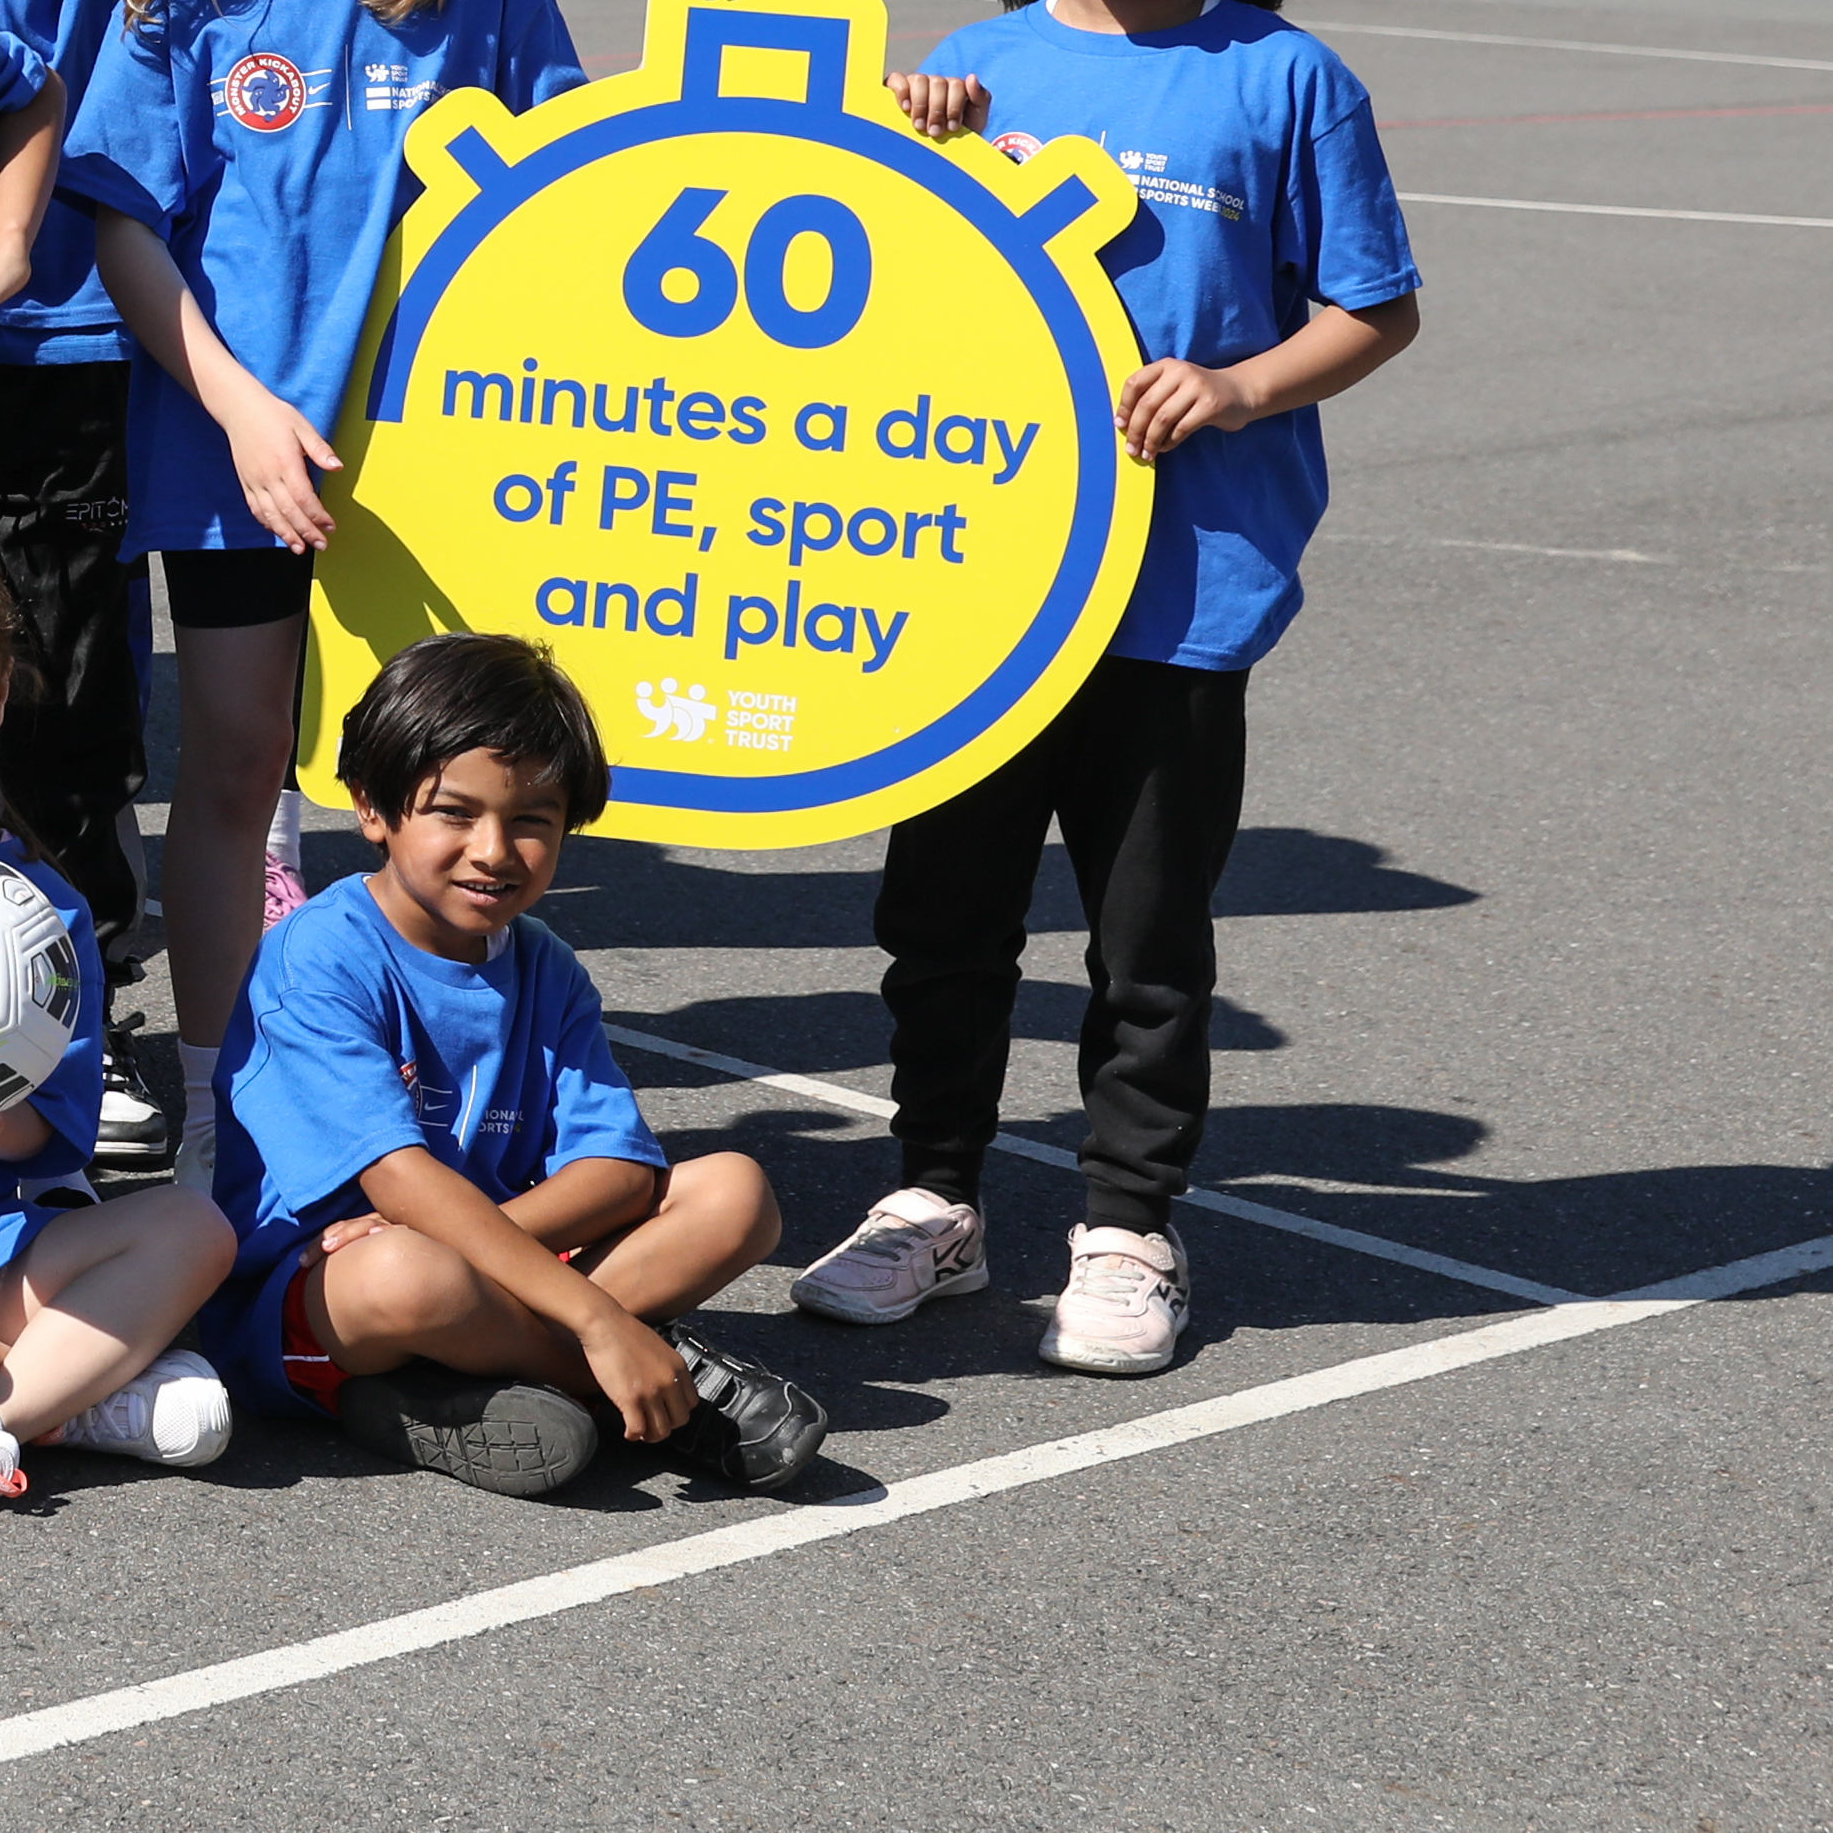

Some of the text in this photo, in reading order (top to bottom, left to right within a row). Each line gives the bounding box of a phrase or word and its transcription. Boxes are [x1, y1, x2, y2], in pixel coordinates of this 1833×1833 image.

[230, 58, 301, 116] MONSTER KICKABOUT
[1144, 164, 1166, 173] TRUST
[1145, 152, 1168, 162] YOUTH
[1145, 158, 1167, 167] SPORT
[1139, 188, 1189, 207] SPORTS
[1140, 175, 1245, 211] NATIONAL SCHOOL
[622, 186, 872, 349] 60
[442, 358, 1041, 485] minutes a day
[493, 460, 968, 567] of PE, sport
[535, 574, 910, 675] and play
[727, 690, 798, 713] YOUTH
[726, 709, 796, 732] SPORT
[725, 729, 795, 752] TRUST
